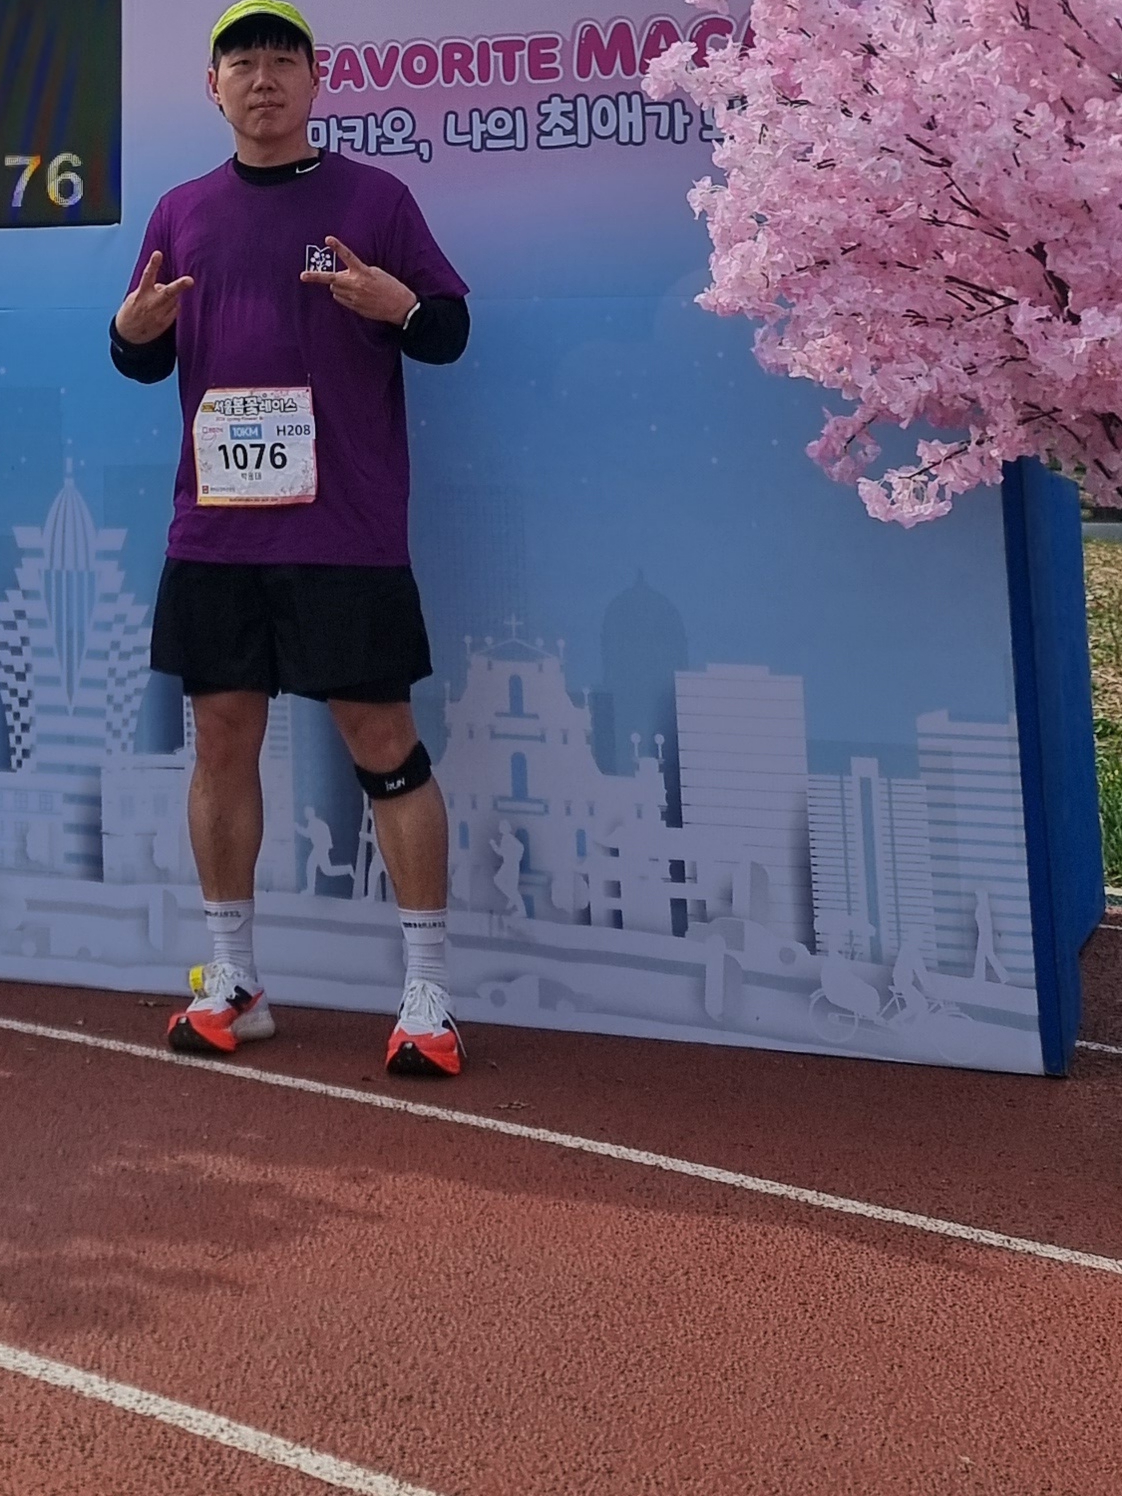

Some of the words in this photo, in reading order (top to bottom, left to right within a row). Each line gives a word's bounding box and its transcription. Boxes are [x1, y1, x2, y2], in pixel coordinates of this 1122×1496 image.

[308, 108, 433, 162] 마카오,
[444, 106, 527, 152] 나의
[537, 91, 692, 149] 최애가
[213, 396, 297, 416] 서울봄꽃레이스
[232, 426, 259, 438] 10KM
[276, 425, 311, 436] H208
[218, 442, 288, 470] 1076
